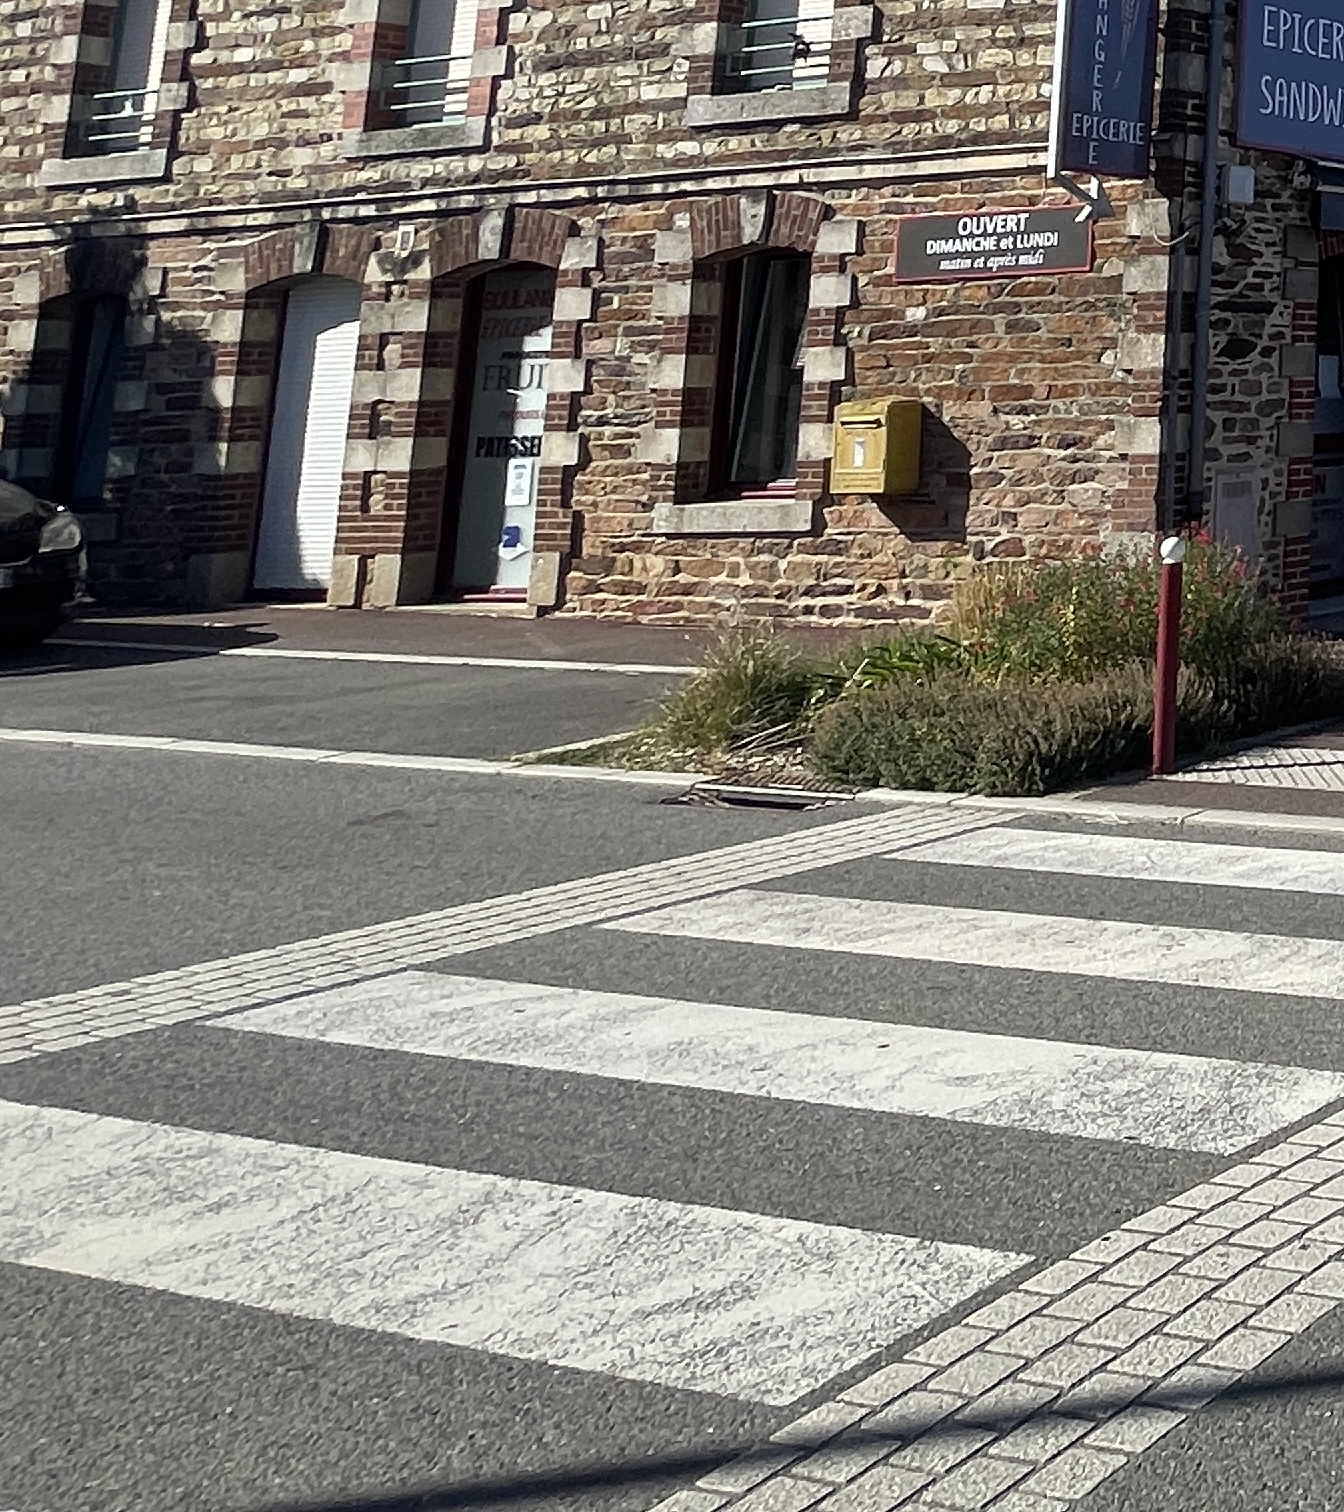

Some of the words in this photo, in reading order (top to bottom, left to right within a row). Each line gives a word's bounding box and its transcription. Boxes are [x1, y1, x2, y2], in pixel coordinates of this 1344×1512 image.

[1071, 112, 1146, 146] EPICERIE
[957, 213, 1030, 236] OUVERT
[925, 237, 998, 255] DIMANCHE
[1000, 237, 1014, 250] et
[1016, 232, 1059, 250] LUNDI
[938, 256, 972, 271] matin
[972, 255, 986, 269] et
[986, 251, 1017, 272] après
[1018, 248, 1046, 266] midi
